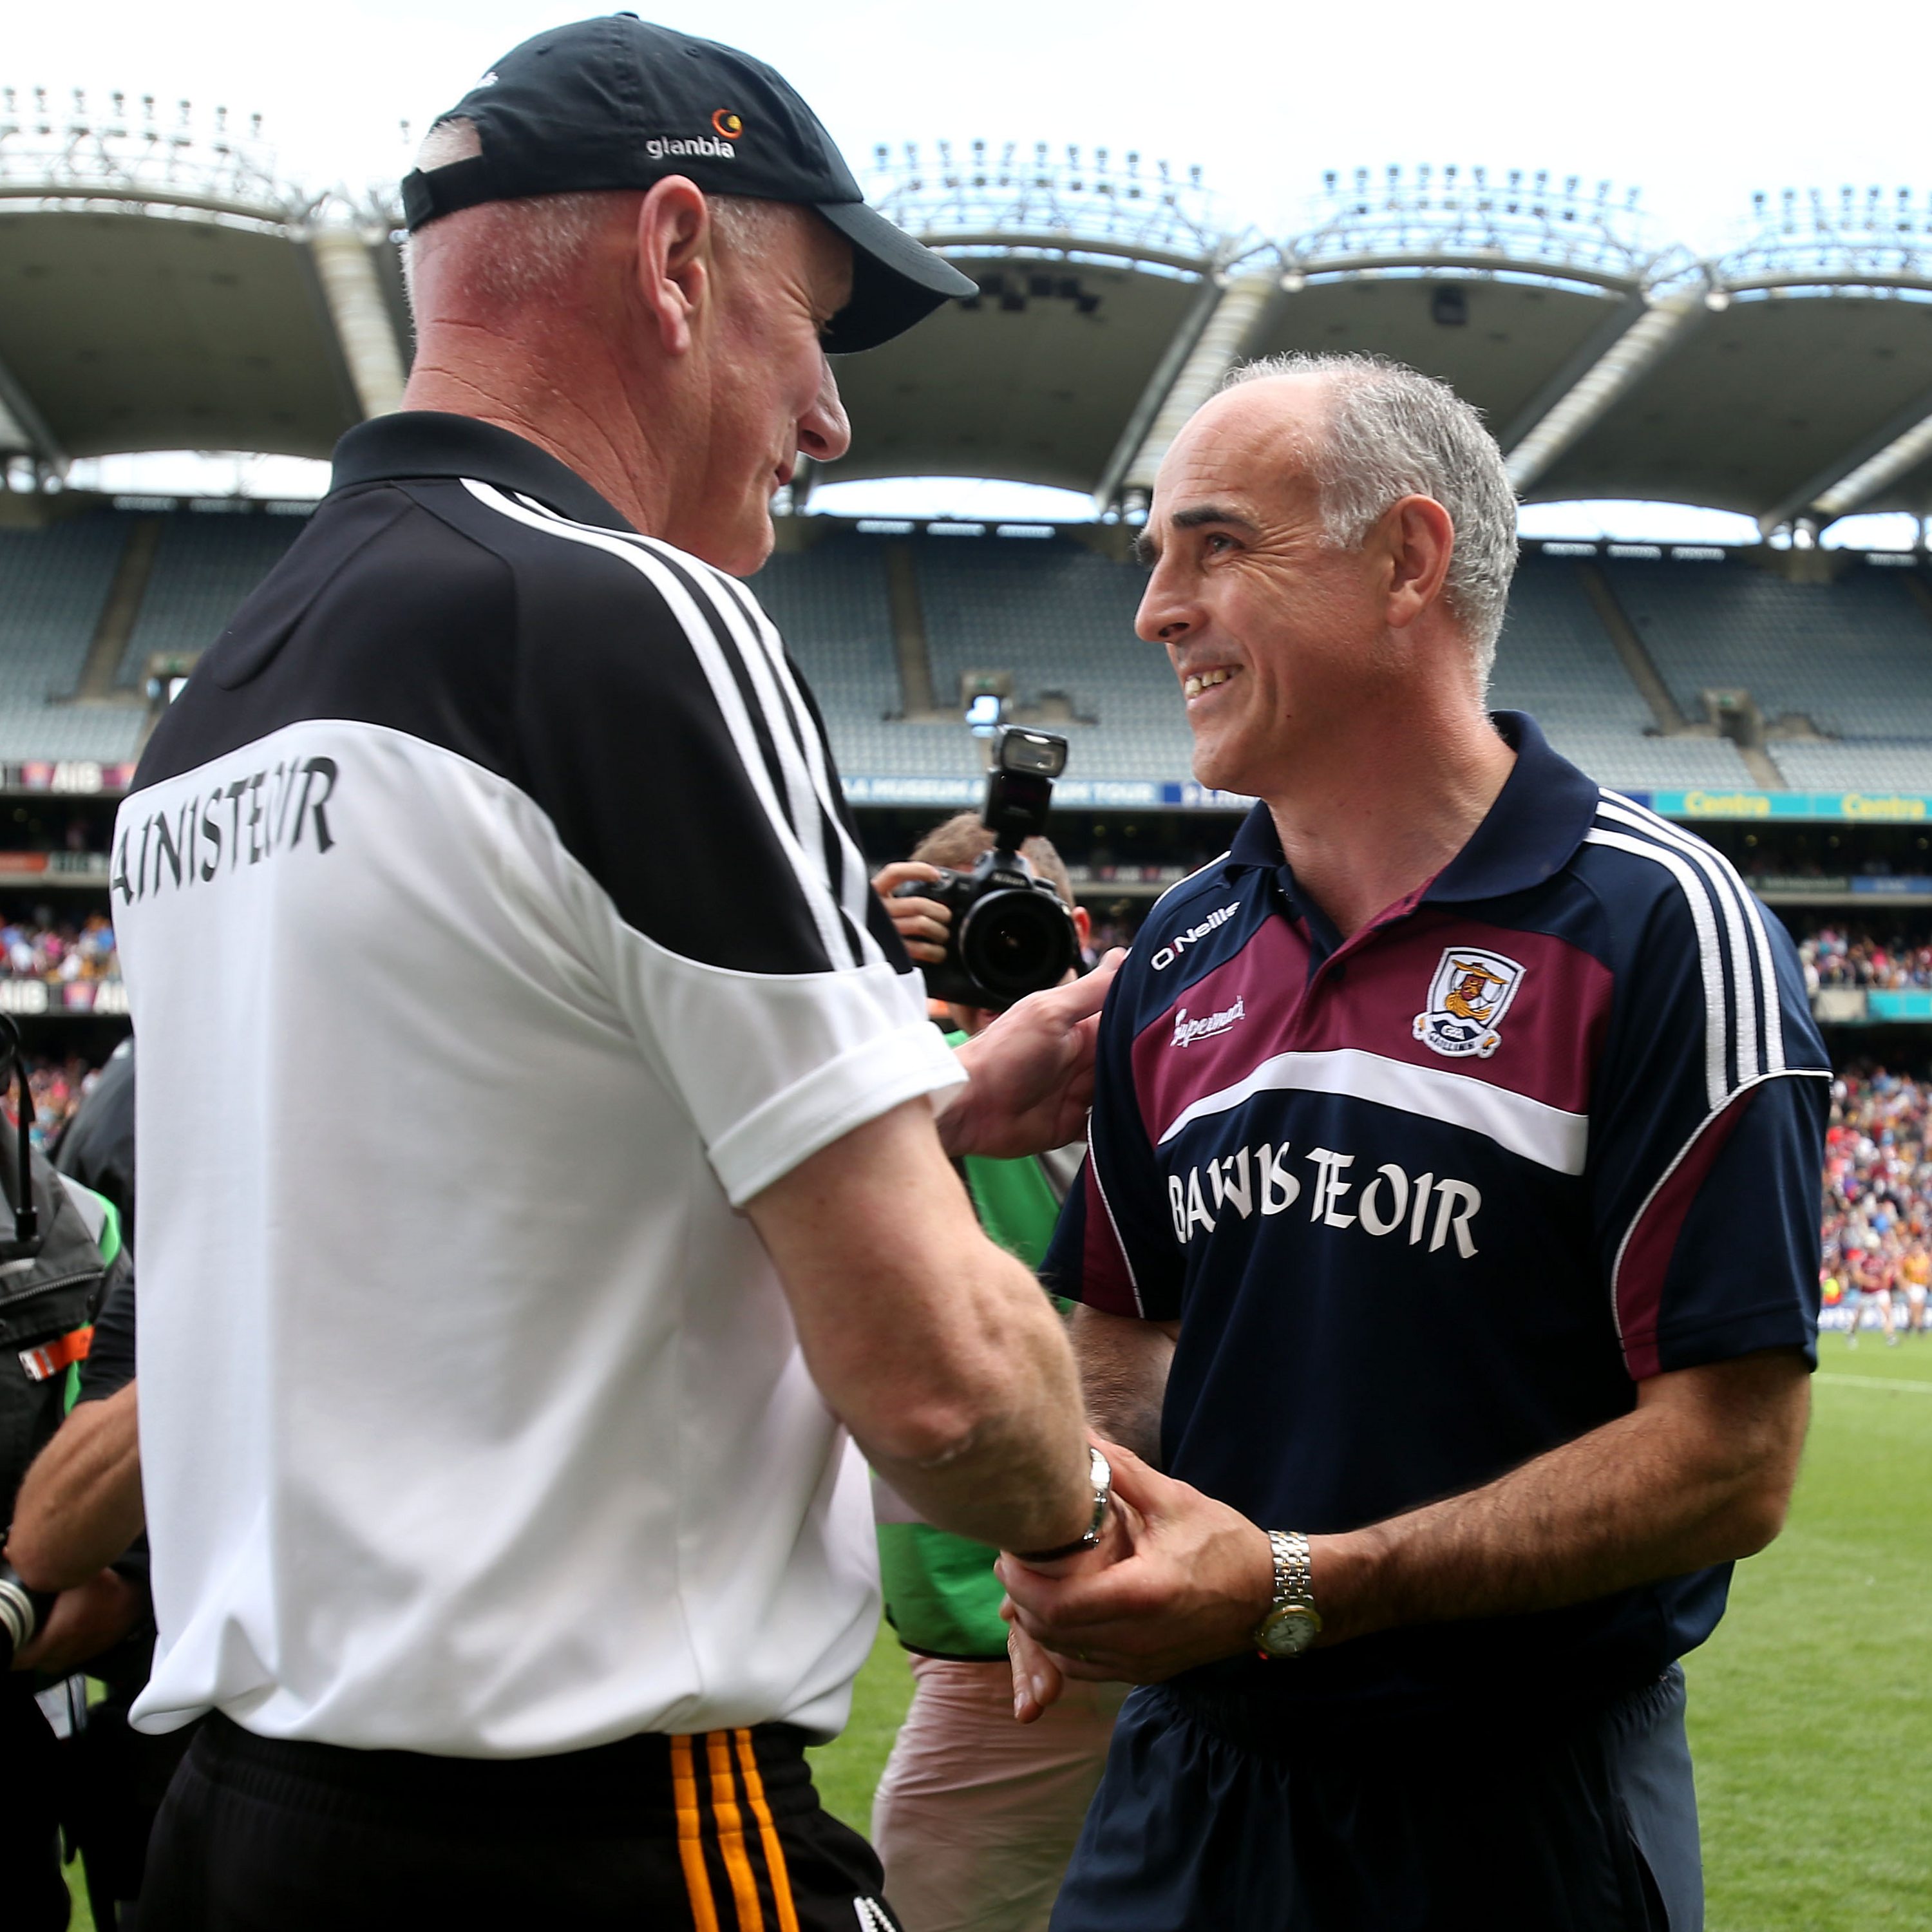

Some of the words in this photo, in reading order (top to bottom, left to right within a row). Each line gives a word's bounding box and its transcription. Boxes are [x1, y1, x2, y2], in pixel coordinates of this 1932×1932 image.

[645, 135, 735, 160] glanbia
[51, 760, 102, 794] AIB
[1094, 781, 1156, 804] TOUR
[1684, 791, 1770, 817] Centra
[1842, 793, 1926, 821] Centra
[1168, 1142, 1481, 1258] BAINISTEOIR
